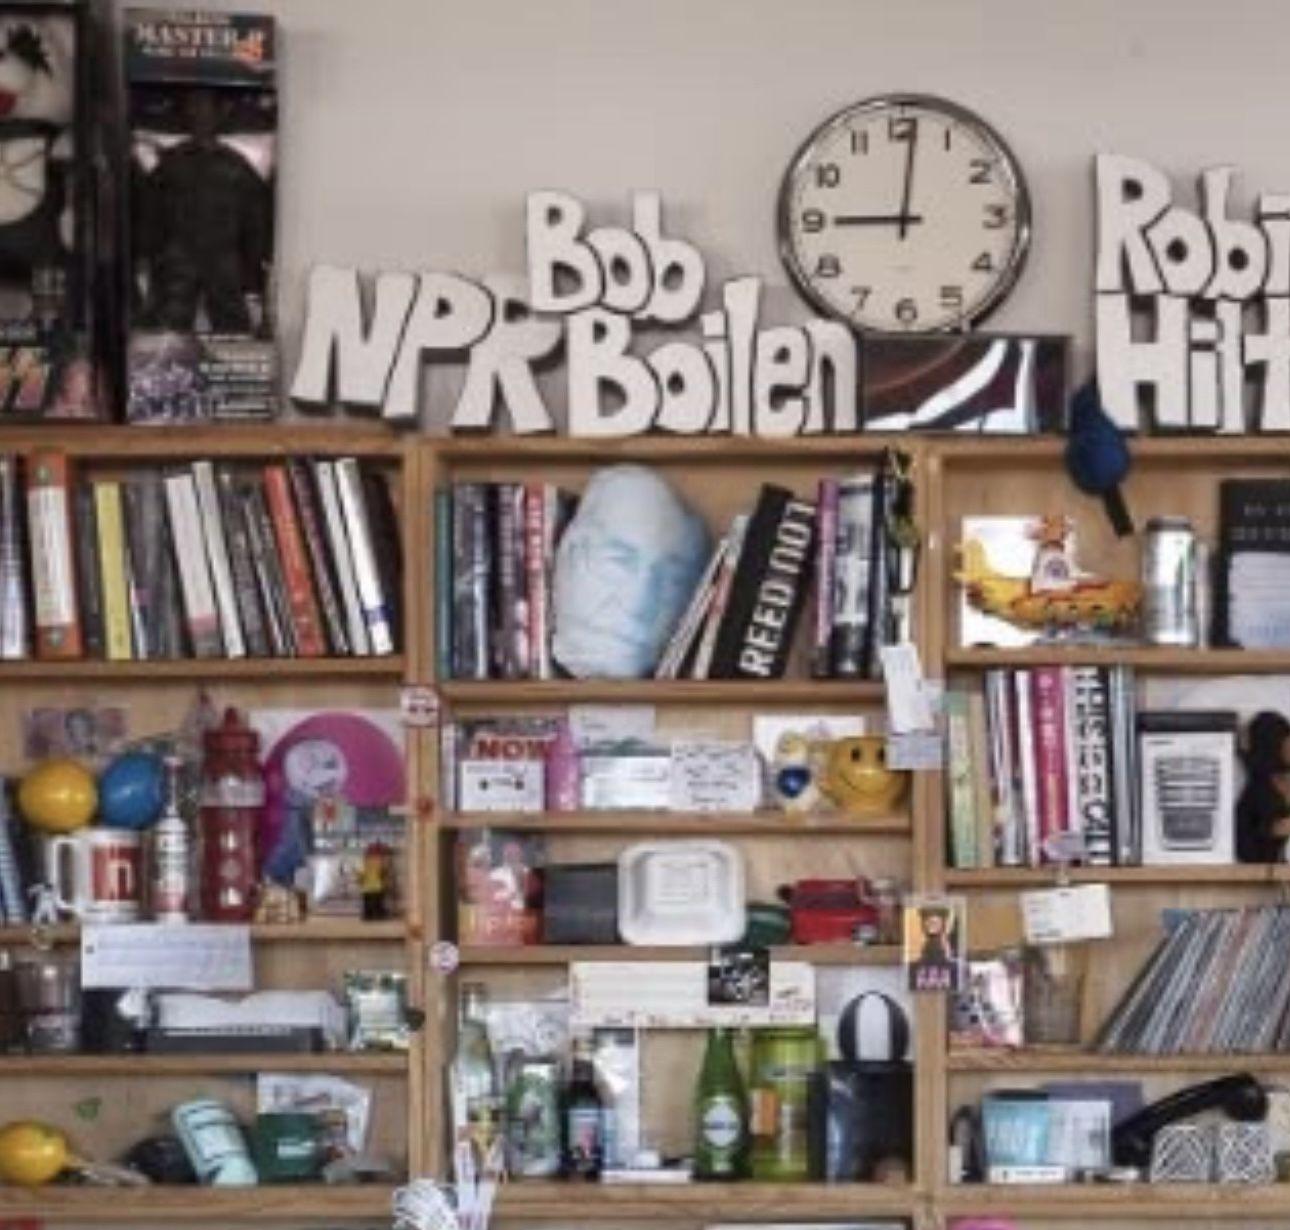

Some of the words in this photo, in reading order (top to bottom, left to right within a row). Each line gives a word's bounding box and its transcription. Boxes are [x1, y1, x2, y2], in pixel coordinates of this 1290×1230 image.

[816, 163, 840, 188] 10
[968, 159, 992, 184] 2
[801, 209, 825, 233] 9
[983, 203, 1008, 229] 3
[525, 189, 705, 322] Bob
[815, 254, 841, 278] 8
[971, 251, 992, 272] 4
[851, 286, 872, 309] 7
[940, 285, 963, 307] 5
[895, 298, 917, 325] 6
[290, 262, 555, 434] NPR
[567, 275, 857, 438] Boilen
